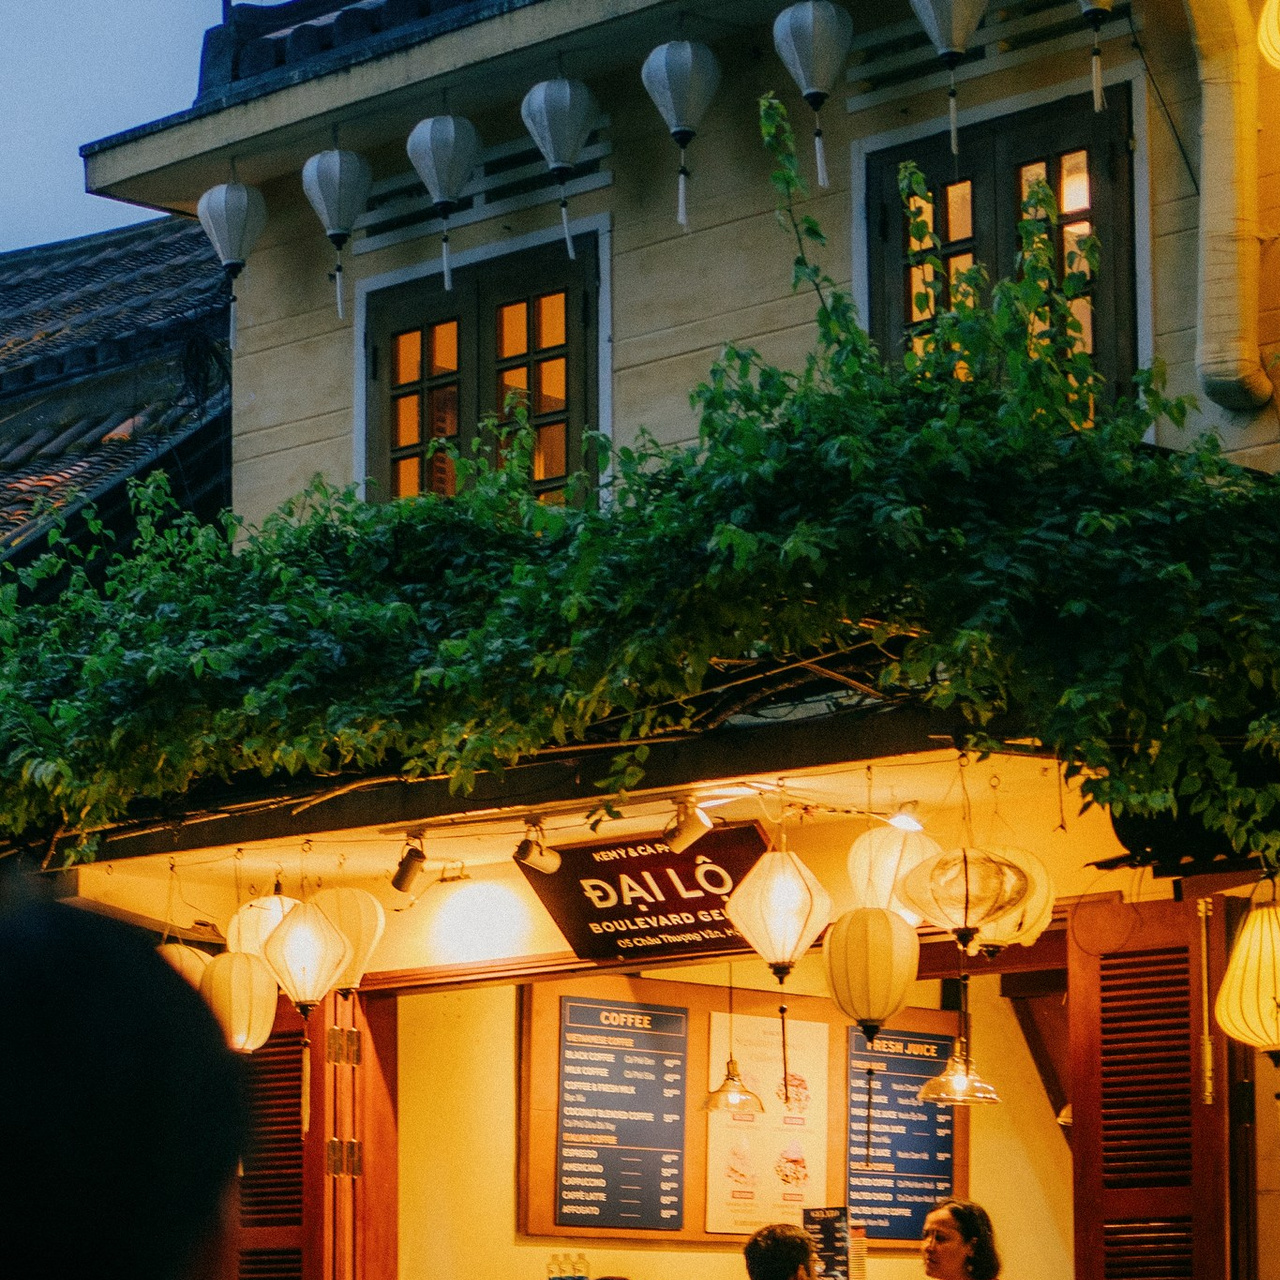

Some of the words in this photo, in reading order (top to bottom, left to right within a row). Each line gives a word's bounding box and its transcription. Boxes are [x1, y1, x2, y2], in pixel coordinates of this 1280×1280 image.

[579, 871, 666, 911] ĐẠI
[665, 855, 733, 902] LỘ
[588, 912, 695, 934] BOULEVARD
[600, 1011, 652, 1029] COFFEE
[904, 1042, 938, 1057] JUICE
